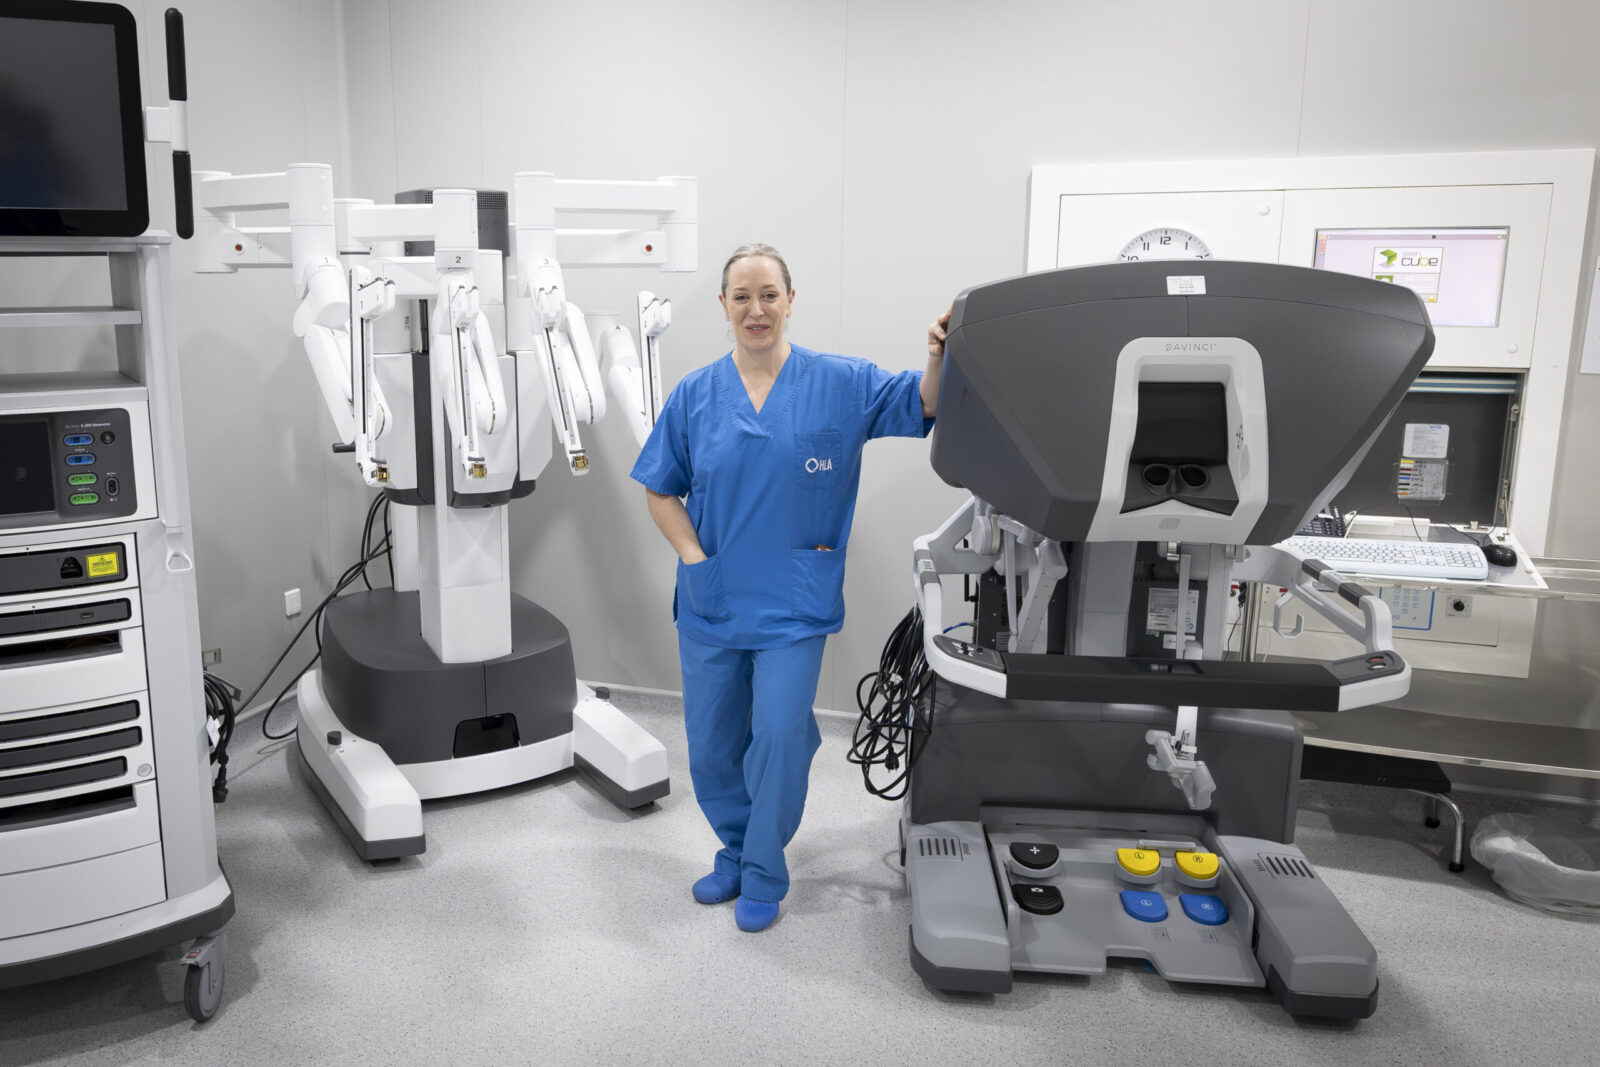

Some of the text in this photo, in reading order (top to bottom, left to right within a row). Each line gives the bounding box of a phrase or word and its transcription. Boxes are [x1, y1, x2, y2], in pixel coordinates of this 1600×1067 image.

[1160, 236, 1172, 245] 12
[1143, 242, 1150, 251] 11
[455, 256, 462, 264] 2
[1401, 256, 1439, 267] cube
